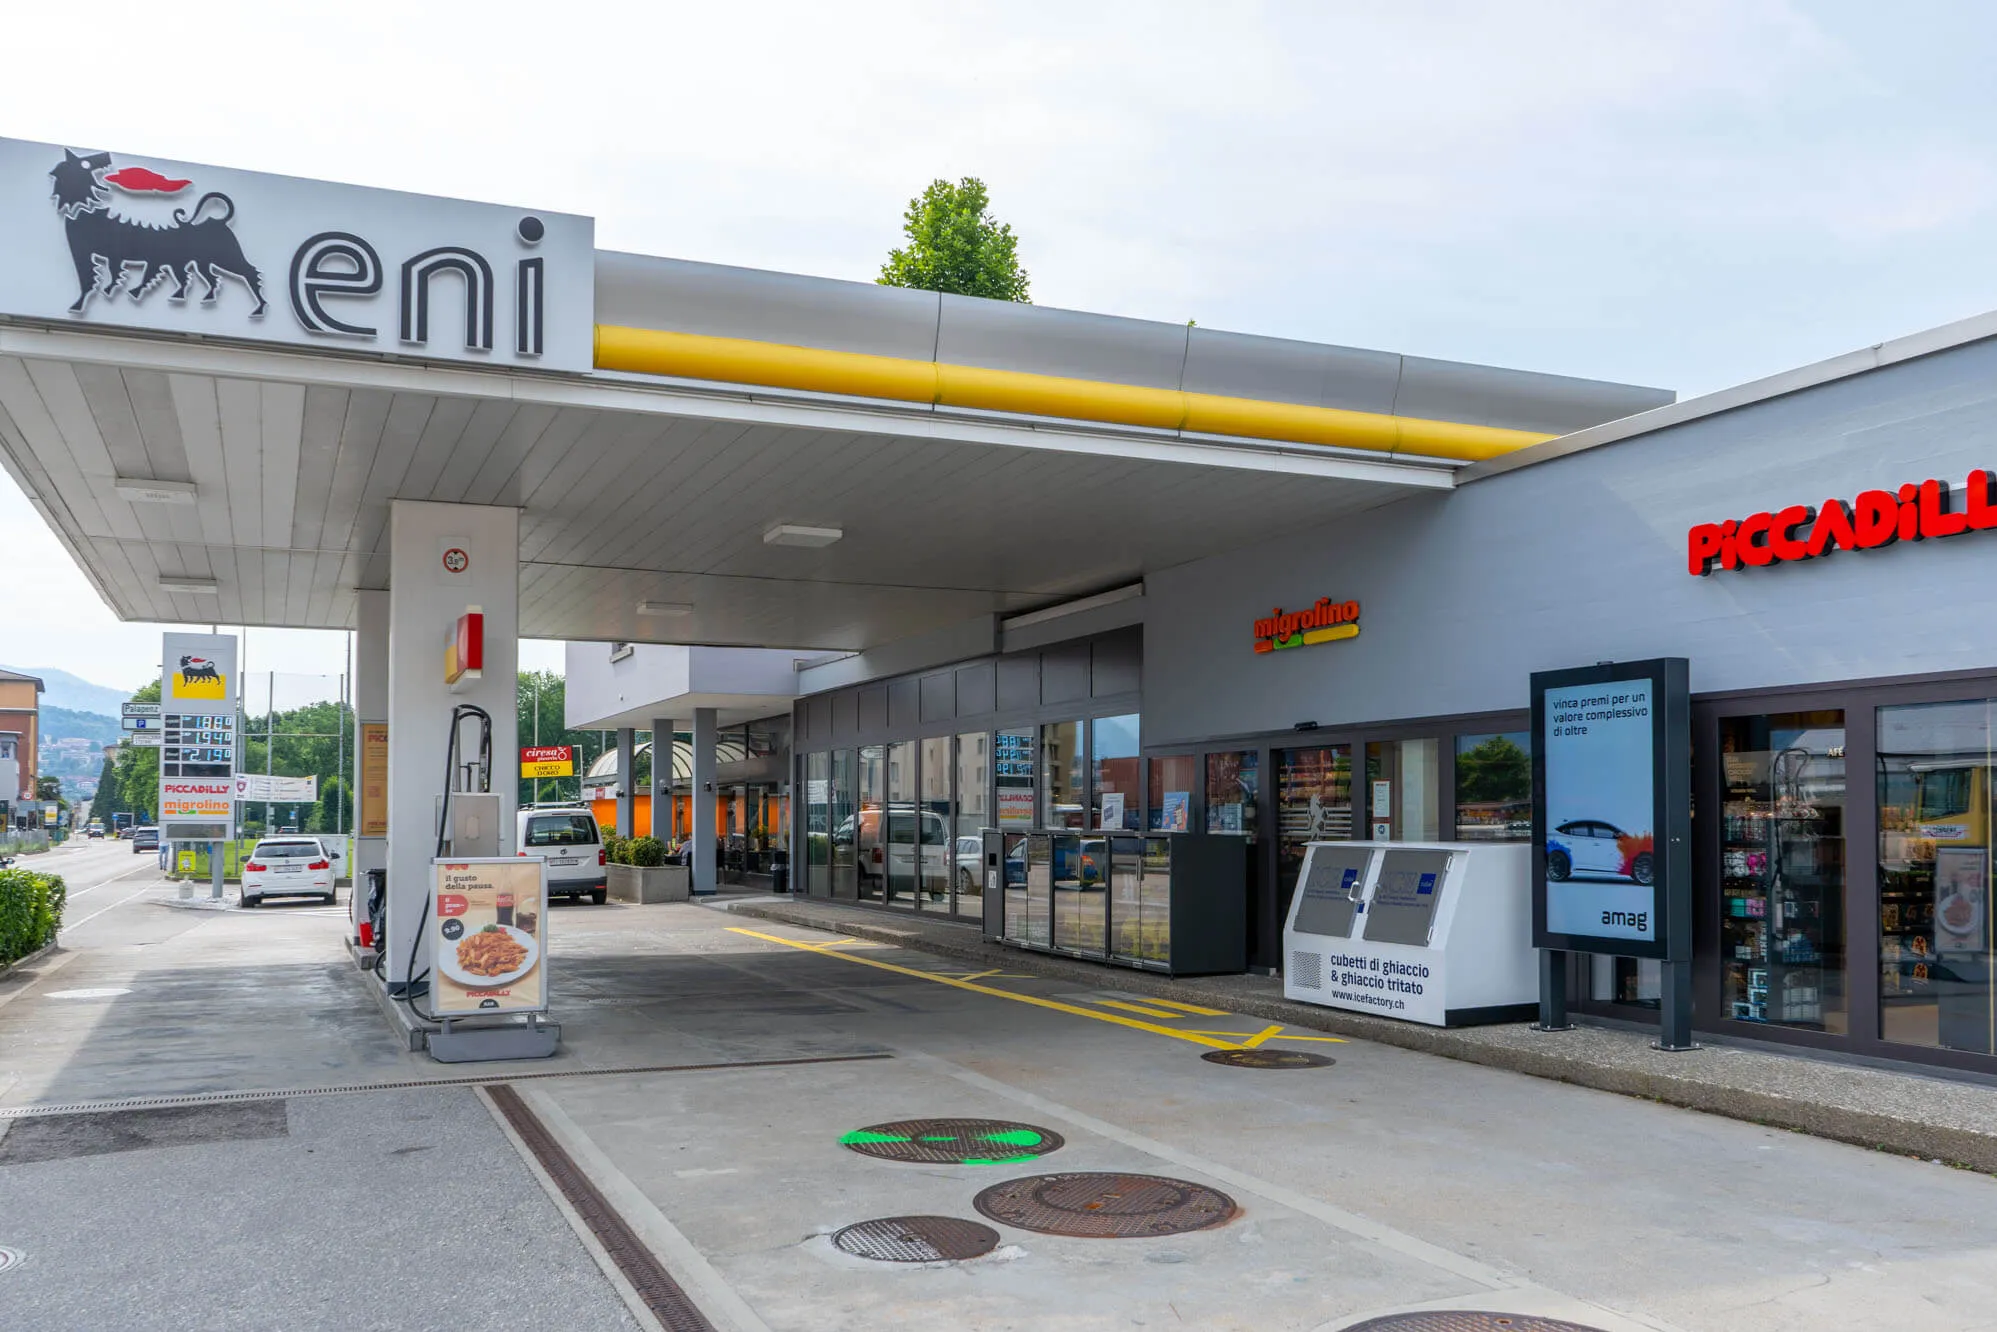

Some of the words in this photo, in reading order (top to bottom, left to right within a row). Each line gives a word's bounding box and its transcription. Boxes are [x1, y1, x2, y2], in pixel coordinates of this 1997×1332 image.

[289, 215, 546, 357] eni
[1253, 596, 1360, 642] migrolino
[1553, 699, 1578, 709] vinca
[1580, 694, 1609, 709] premi
[1612, 694, 1629, 706] per
[1632, 692, 1646, 703] un
[1553, 711, 1583, 723] valore
[1585, 706, 1649, 721] complessivo
[1553, 726, 1563, 737] di
[1565, 725, 1588, 736] oltre
[526, 747, 558, 758] ciresa
[164, 799, 229, 811] migrolino
[453, 875, 478, 883] gusto
[1601, 911, 1648, 932] amag
[1330, 954, 1367, 969] cubetti
[1369, 958, 1380, 971] di
[1382, 960, 1430, 978] ghiaccio
[1331, 970, 1339, 982] &
[1341, 972, 1385, 989] ghiaccio
[1387, 978, 1424, 995] tritato
[1331, 989, 1405, 1010] www.icefactory.ch
